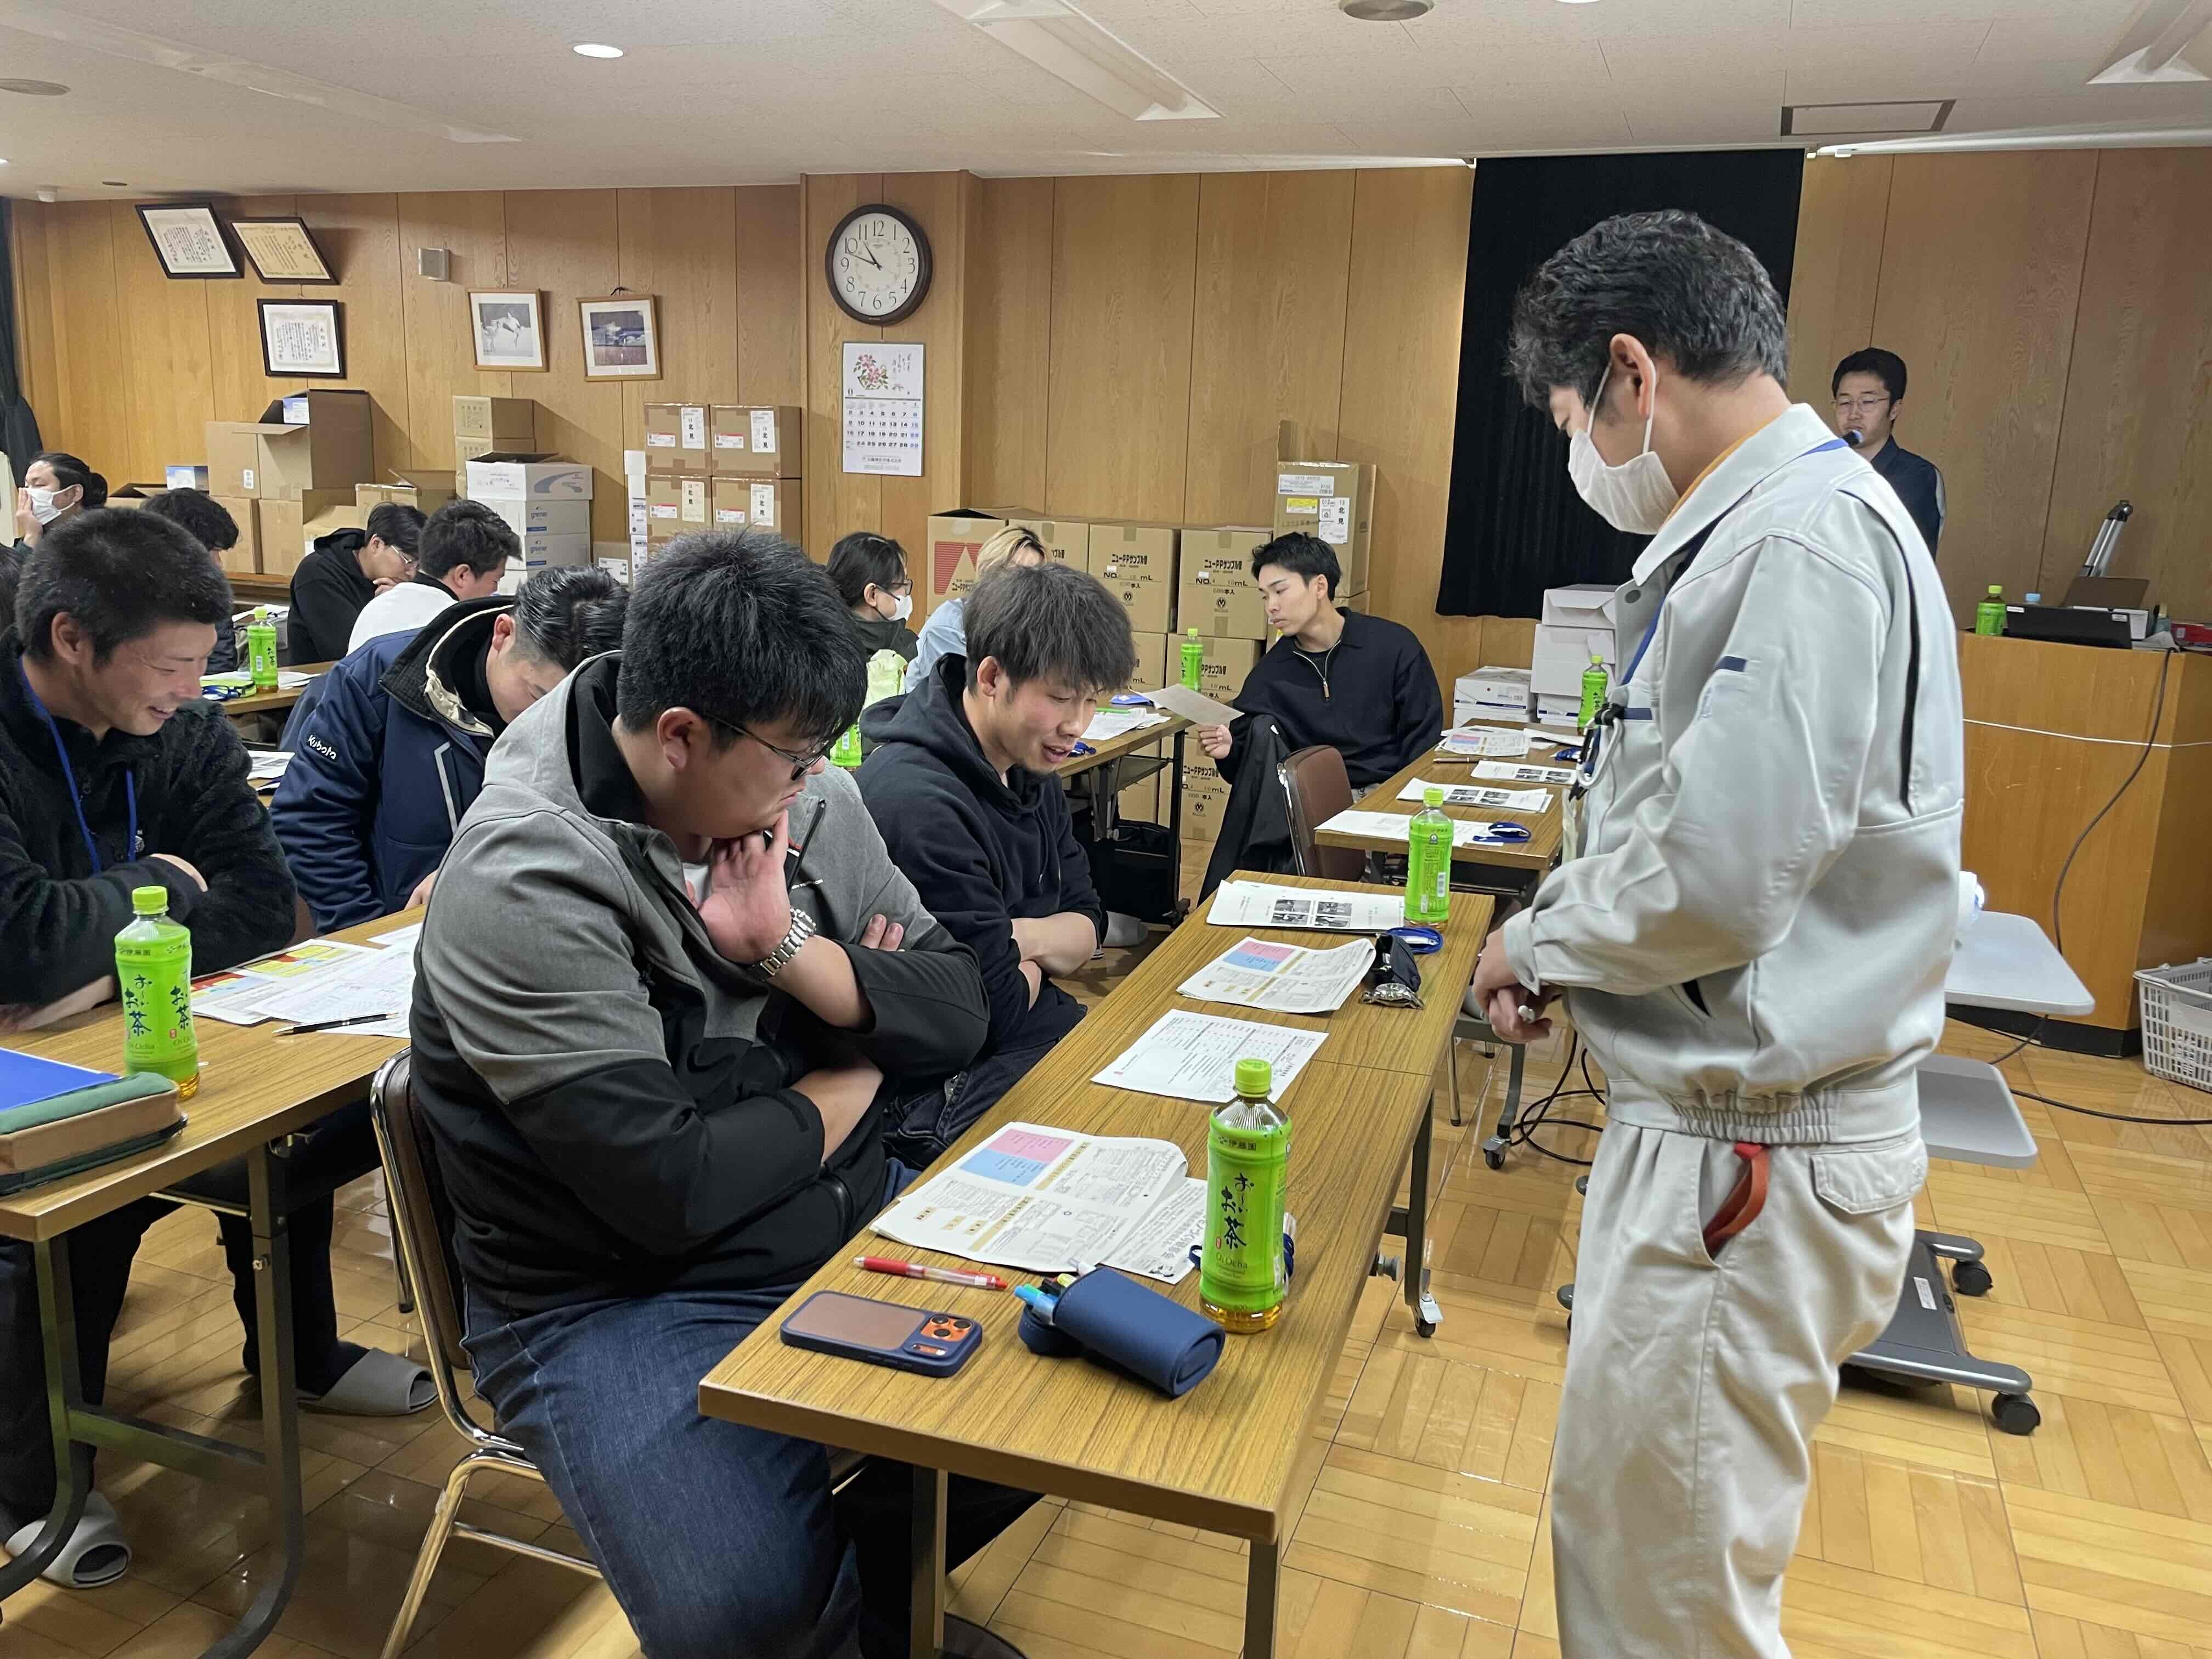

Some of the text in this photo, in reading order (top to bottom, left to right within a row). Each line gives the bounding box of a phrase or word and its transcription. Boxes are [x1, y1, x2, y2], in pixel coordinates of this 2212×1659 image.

[859, 224, 867, 240] 11
[873, 221, 884, 236] 12
[845, 237, 858, 253] 10
[902, 238, 910, 253] 2
[840, 257, 849, 273] 9
[908, 258, 916, 274] 3
[846, 276, 855, 292] 8
[900, 277, 908, 294] 4
[858, 291, 866, 307] 7
[873, 294, 882, 310] 6
[889, 291, 896, 308] 5
[308, 734, 337, 760] Kubota
[125, 988, 153, 1036] お茶
[170, 985, 189, 1031] お茶
[1221, 1185, 1247, 1250] お茶
